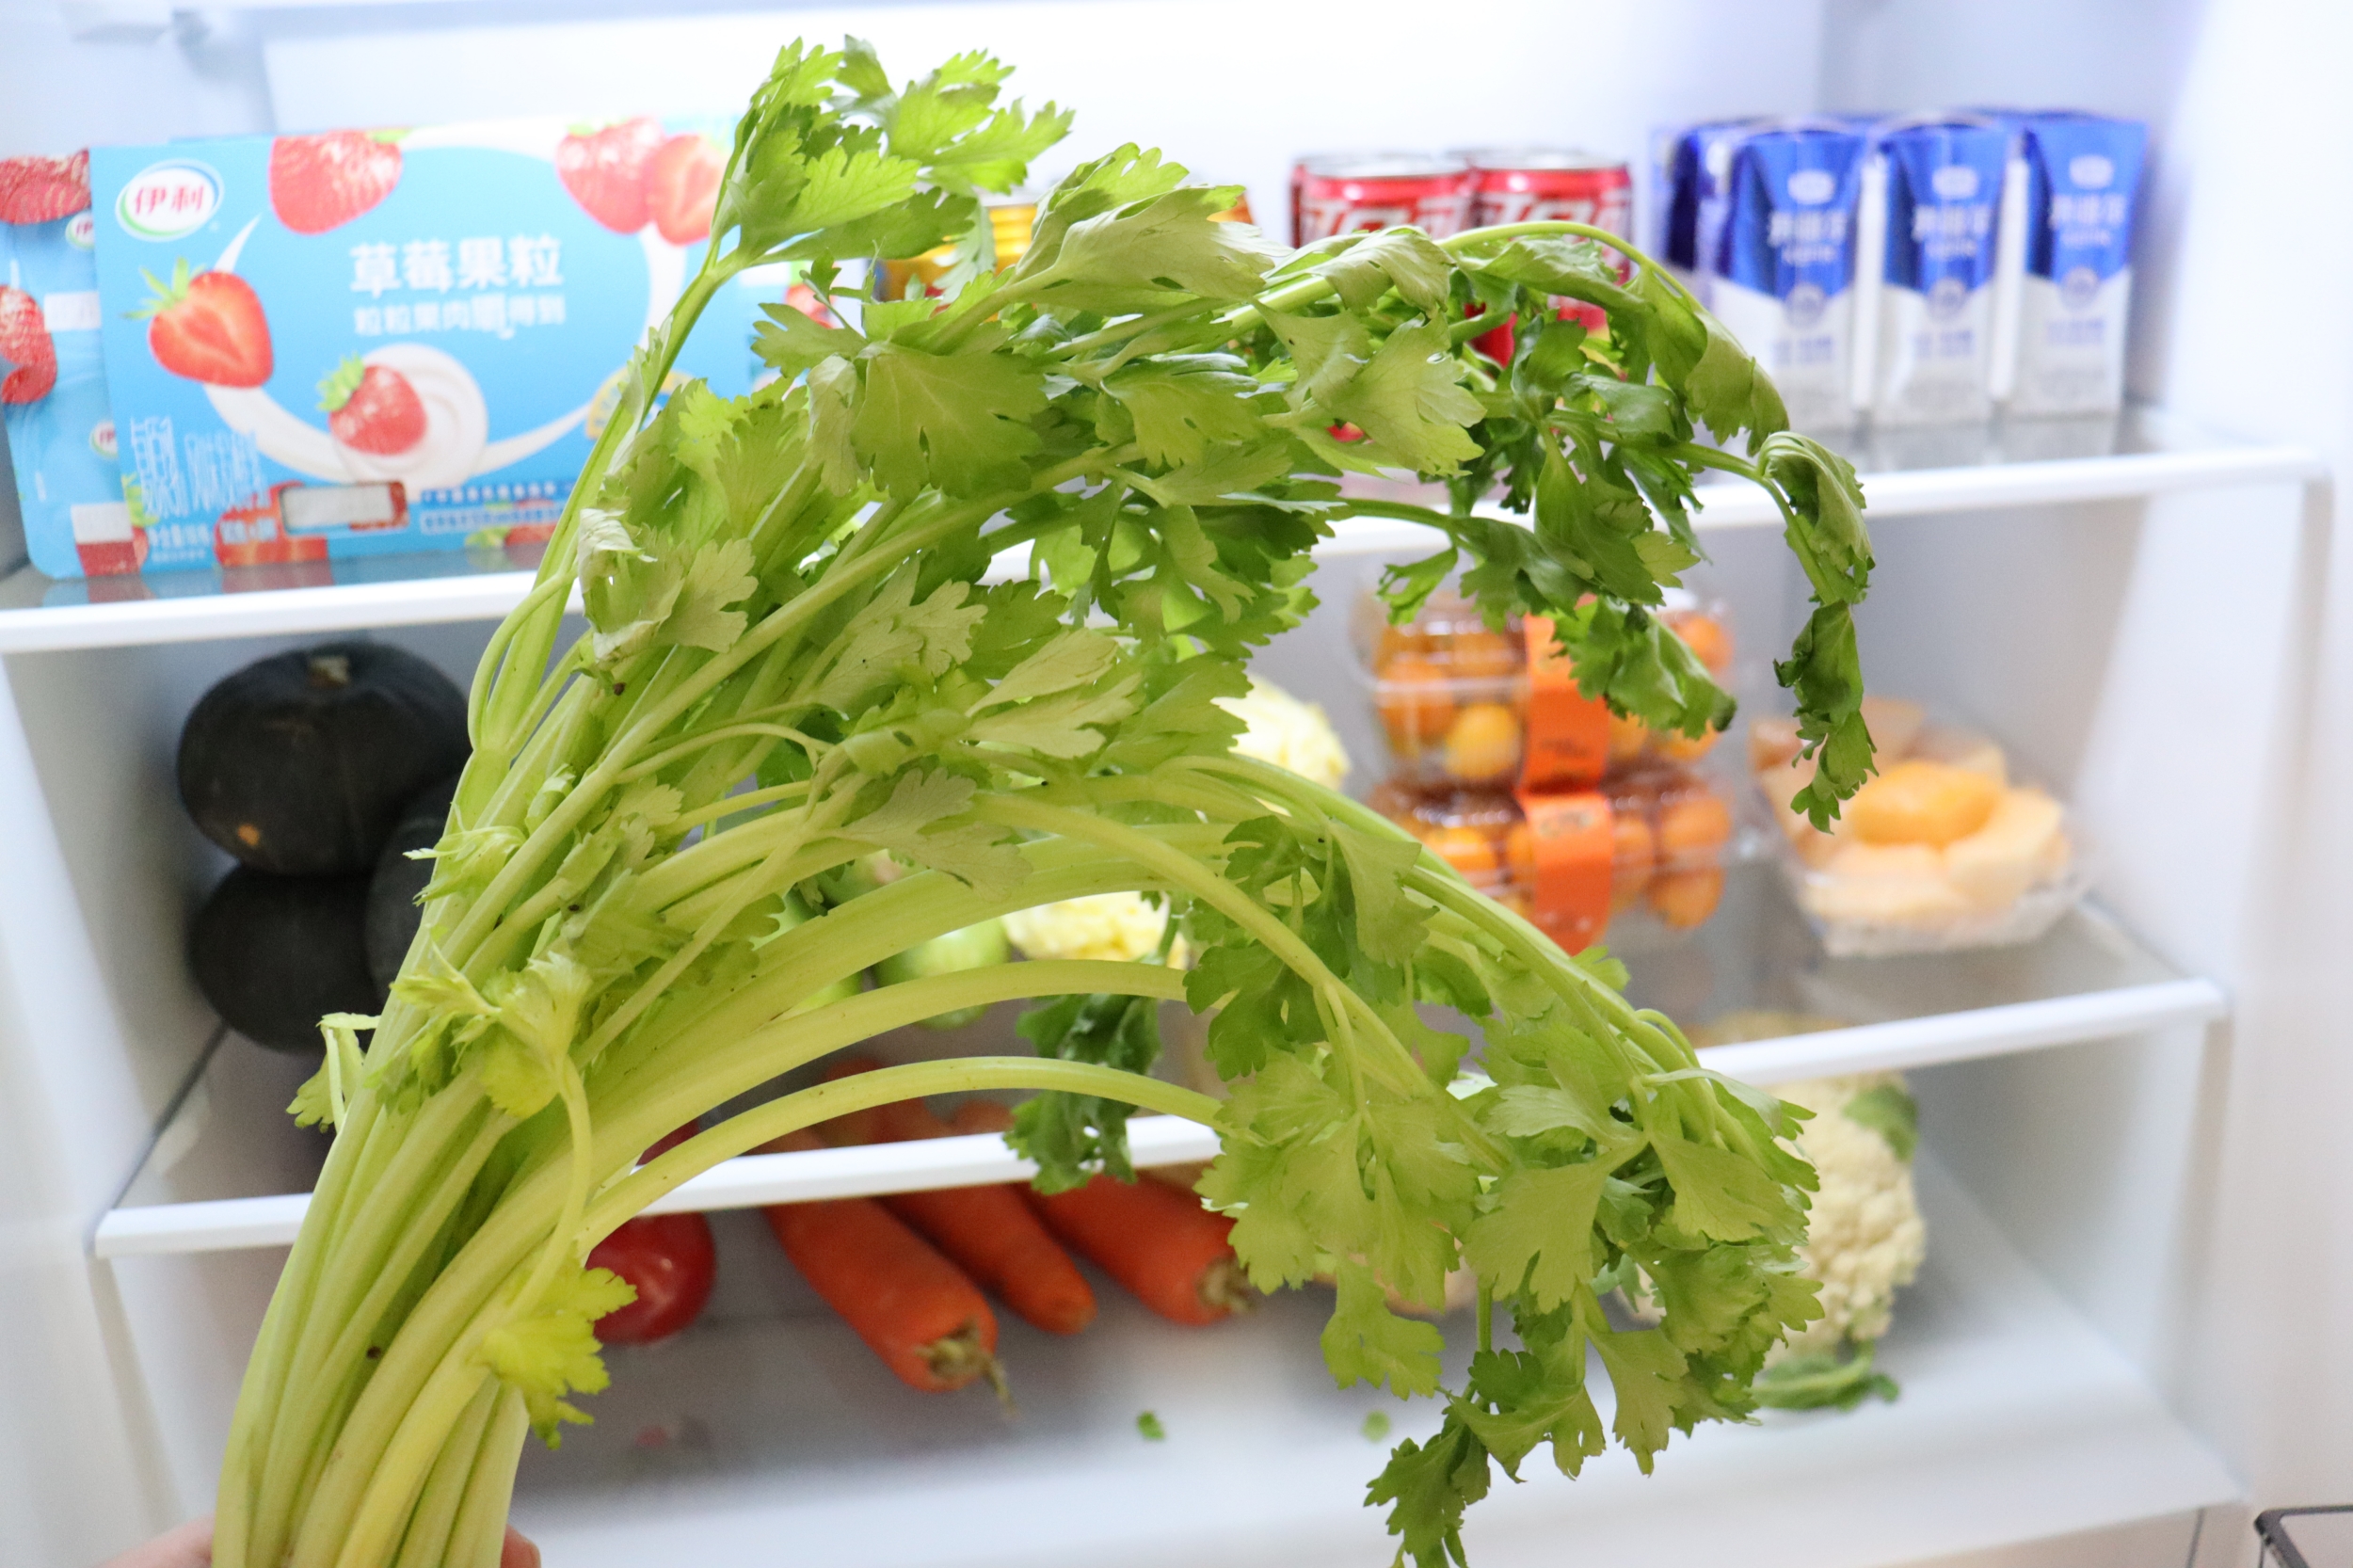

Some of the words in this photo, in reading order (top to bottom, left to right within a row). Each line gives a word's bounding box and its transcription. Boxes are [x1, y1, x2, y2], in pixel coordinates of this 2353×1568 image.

[135, 184, 204, 215] 伊利
[349, 233, 565, 299] 草莓果粒
